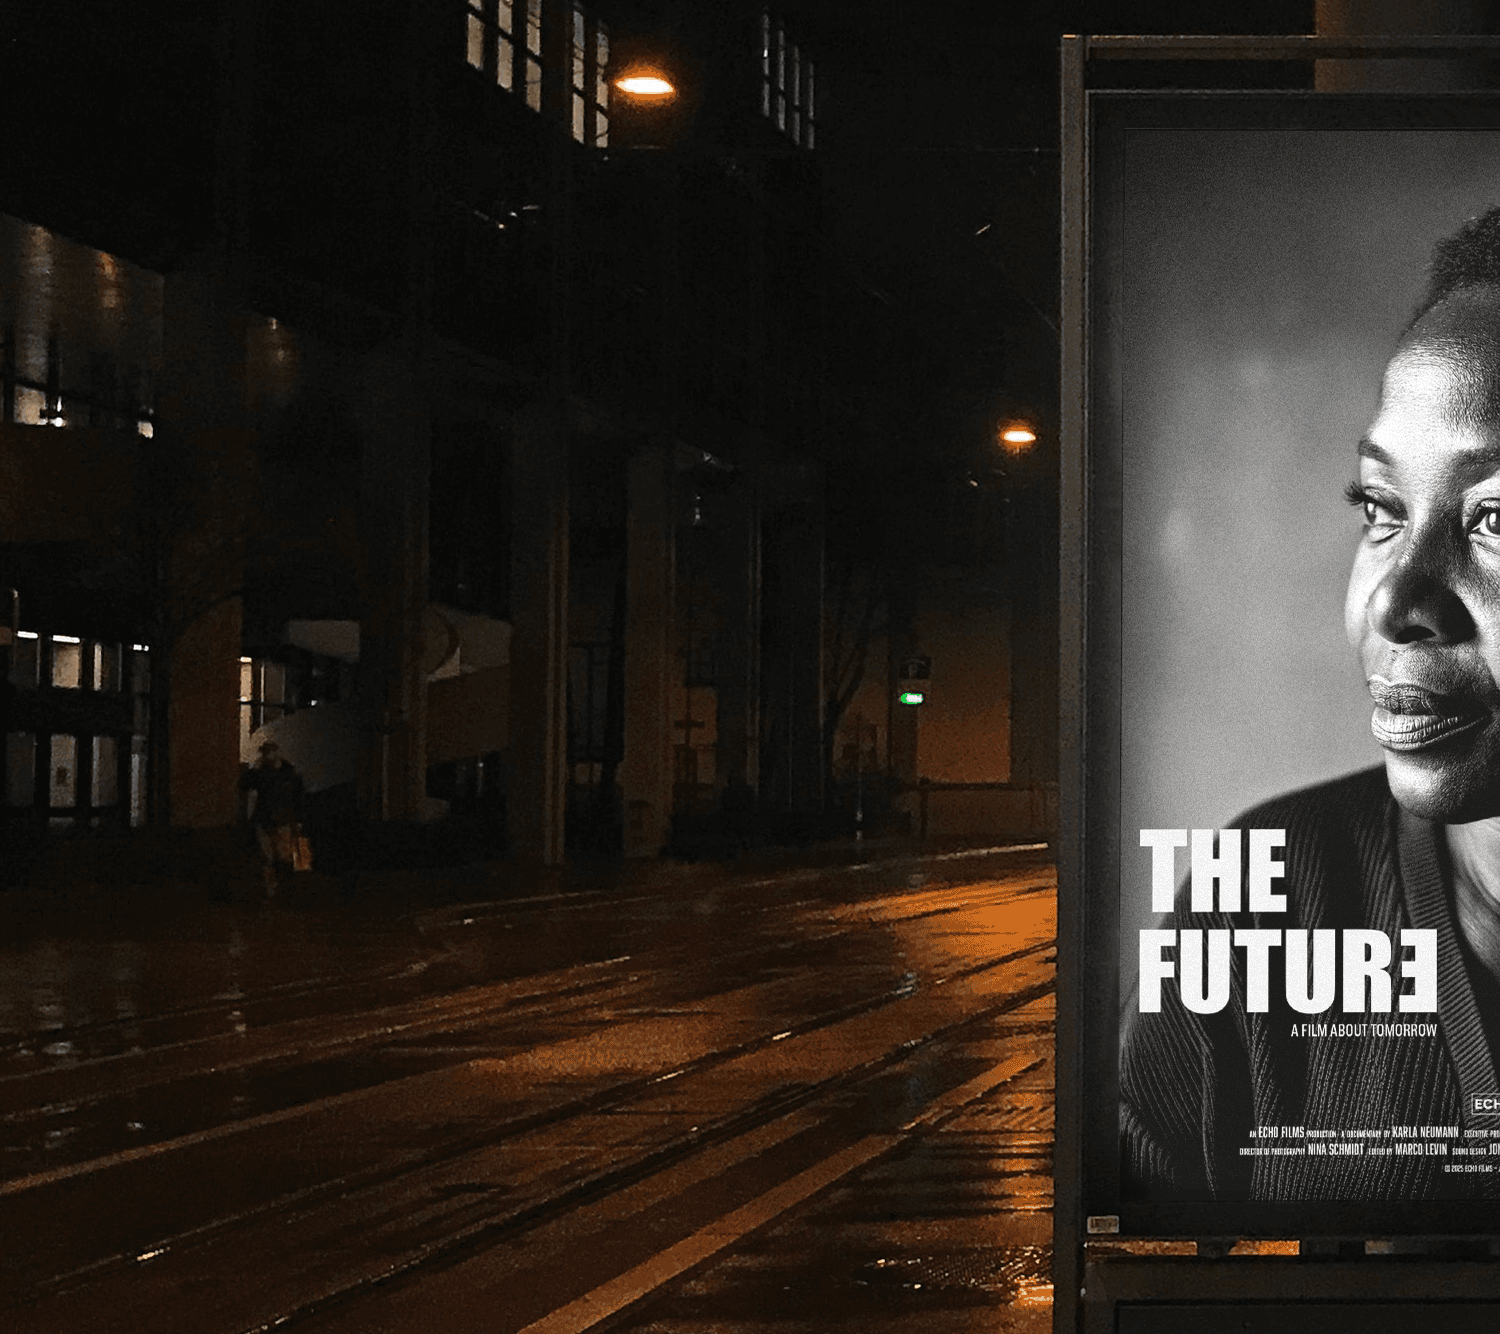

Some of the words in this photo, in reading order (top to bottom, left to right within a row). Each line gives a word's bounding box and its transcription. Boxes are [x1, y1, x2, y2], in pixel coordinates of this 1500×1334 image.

[1139, 828, 1287, 913] THE
[1291, 1024, 1298, 1037] A
[1302, 1024, 1327, 1037] FILM
[1330, 1024, 1368, 1037] ABOUT
[1370, 1024, 1437, 1037] TOMORROW
[1259, 1126, 1278, 1138] ECHO
[1281, 1126, 1305, 1138] FILMS
[1384, 1130, 1390, 1138] BY
[1392, 1126, 1418, 1138] KARLA
[1420, 1126, 1459, 1138] NEUMANN
[1308, 1143, 1327, 1155] NINA
[1329, 1143, 1364, 1155] SCHMIDT
[1395, 1143, 1423, 1155] MARCO
[1426, 1143, 1448, 1155] LEVIN
[1451, 1165, 1464, 1173] 2025
[1465, 1165, 1477, 1173] ECHO
[1478, 1165, 1493, 1173] FILMS
